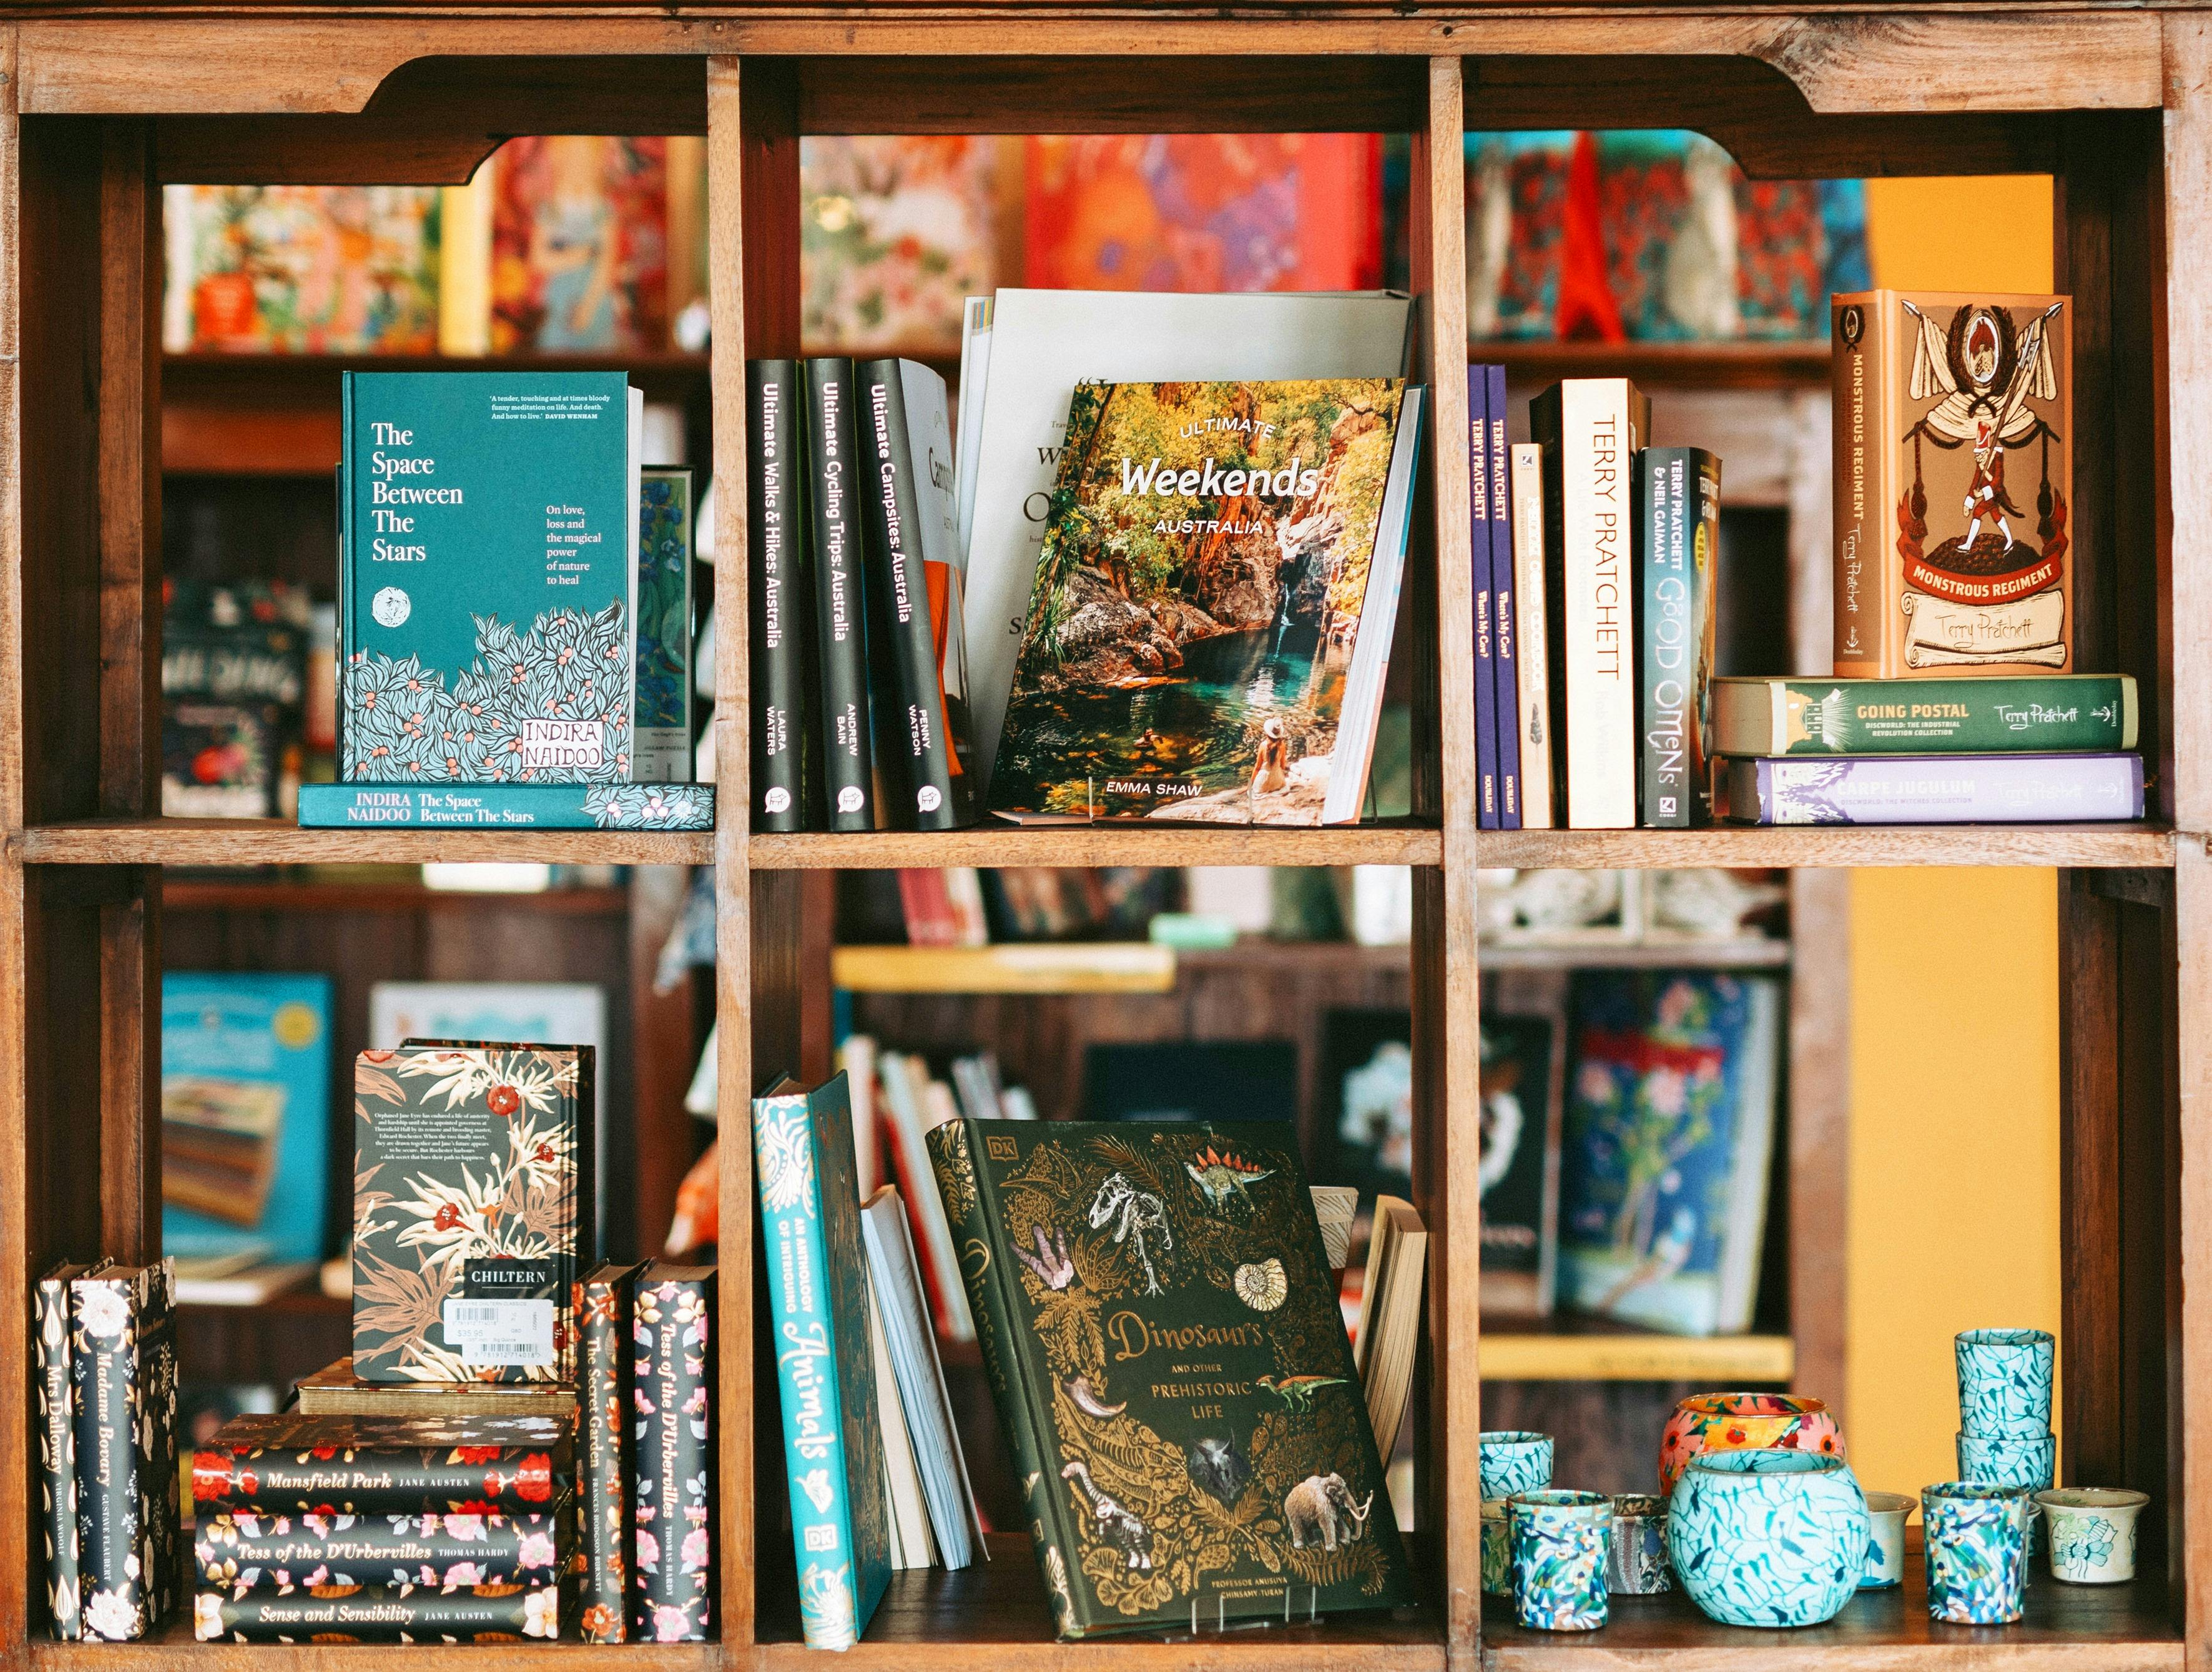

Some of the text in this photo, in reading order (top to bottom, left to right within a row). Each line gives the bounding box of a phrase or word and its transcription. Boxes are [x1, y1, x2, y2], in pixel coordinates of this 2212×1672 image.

[371, 423, 413, 445] The
[1179, 417, 1277, 440] ULTIMATE
[1853, 354, 1864, 519] MONSTROUS REGIMENT
[372, 451, 435, 481] Space
[1472, 418, 1486, 520] TERRY PRATCHETT
[1493, 420, 1506, 521] TERRY PRATCHETT
[1593, 413, 1616, 502] TERRY
[1121, 457, 1319, 497] Weekends
[372, 481, 463, 504] Between
[871, 383, 912, 623] Ultimate Campsites: Australia
[371, 509, 415, 533] The
[546, 505, 585, 516] On love,
[546, 519, 585, 529] loss and
[763, 383, 782, 648] Ultimate Walks & Hikes: Australia
[823, 382, 849, 641] Ultimate Cycling Trips: Australia
[1654, 467, 1666, 564] & NEIL GAIMAN
[1671, 460, 1683, 571] TERRY PRATCHETT
[546, 533, 601, 545] the magical
[1152, 519, 1264, 535] AUSTRALIA
[372, 538, 426, 562] Stars
[546, 548, 578, 559] power
[546, 561, 590, 571] of nature
[1843, 523, 1862, 614] Terry Pratchett
[546, 575, 579, 585] to heal
[1913, 563, 2053, 597] MONSTROUS REGIMENT
[1595, 514, 1619, 681] PRATCHETT
[1477, 621, 1488, 634] My
[1498, 621, 1510, 635] My
[1935, 613, 2035, 649] Terry Pratchett
[1478, 635, 1490, 659] Cow?
[1500, 636, 1511, 659] Cow?
[1857, 704, 1970, 719] GOING POSTAL
[1993, 703, 2079, 730] Terry Pratchett
[525, 722, 599, 742] INDIRA
[767, 706, 775, 756] WATERS
[777, 711, 787, 751] LAURA
[837, 716, 846, 745] BAIN
[847, 703, 858, 756] ANDREW
[908, 704, 922, 756] WATSON
[919, 709, 931, 749] PENNY
[524, 746, 600, 765] NAIDOO
[356, 792, 481, 809] INDIRA The Space
[1106, 781, 1203, 797] EMMA SHAW
[1484, 775, 1493, 813] DOUBLEDAY
[1505, 775, 1514, 814] DOUBLEDAY
[347, 808, 534, 823] NAIDOO Between The Stars
[991, 1142, 1015, 1155] DK
[471, 1271, 546, 1283] CHILTERN
[779, 1219, 797, 1314] OF INTRIGUING
[794, 1217, 813, 1314] AN ANTHOLOGY
[660, 1323, 677, 1357] Tess
[1108, 1311, 1264, 1362] Dinosaurs
[657, 1362, 678, 1381] of
[1171, 1364, 1222, 1374] AND OTHER
[587, 1337, 604, 1468] The Secret Garden
[661, 1384, 678, 1409] the
[779, 1320, 837, 1460] Animals
[1151, 1381, 1252, 1399] PREHISTORIC
[46, 1365, 66, 1475] Mrs Dalloway
[96, 1352, 114, 1487] Madame Bovary
[1191, 1405, 1224, 1420] LIFE
[267, 1473, 470, 1492] Mansfield Park JANE AUSTEN
[55, 1482, 65, 1555] VIRGINIA WOOLF
[101, 1494, 111, 1581] GUSTAVE FLAUBERT
[809, 1531, 832, 1547] DK
[237, 1543, 270, 1560] Tess
[275, 1543, 293, 1563] of
[297, 1543, 322, 1560] the
[438, 1548, 476, 1557] THOMAS
[478, 1548, 509, 1557] HARDY
[664, 1525, 674, 1596] THOMAS HARDY
[1212, 1576, 1288, 1588] PROFESSOR ANUSUYA
[259, 1604, 493, 1625] Sense and Sensibility JANE AUSTEN
